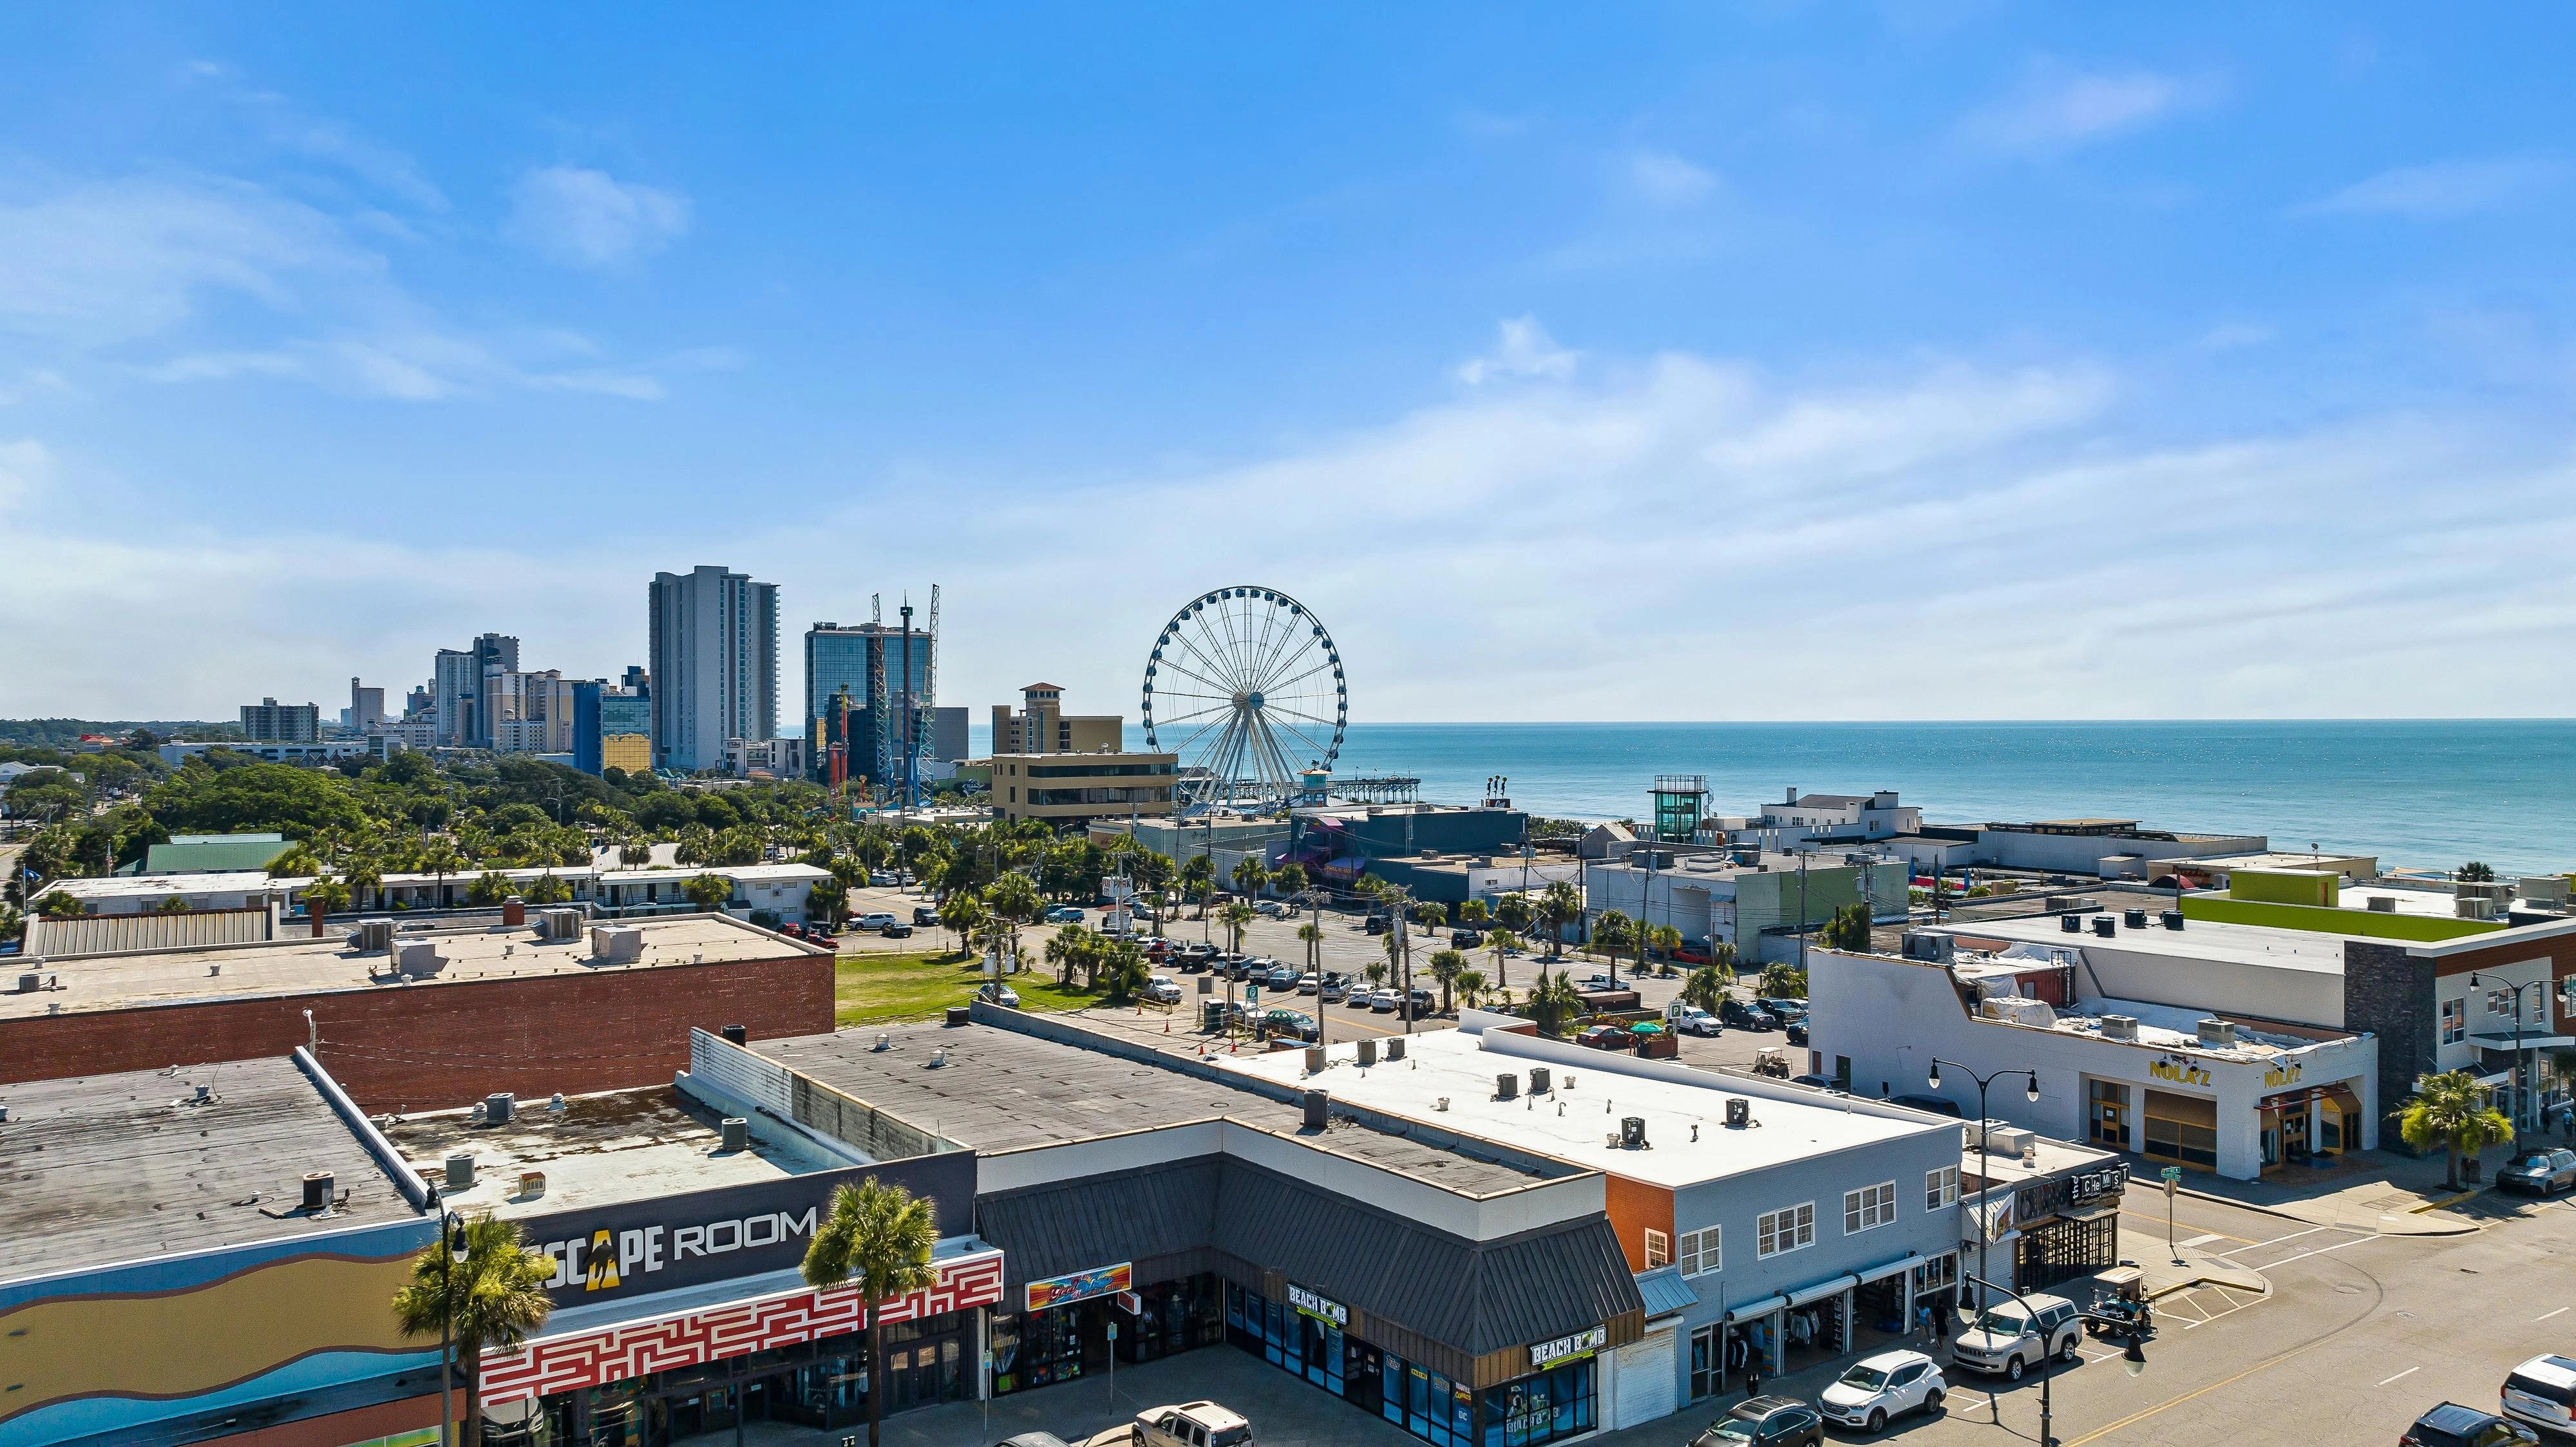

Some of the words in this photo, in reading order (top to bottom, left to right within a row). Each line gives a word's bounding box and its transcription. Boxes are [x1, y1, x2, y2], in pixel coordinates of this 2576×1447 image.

[1674, 1007, 1679, 1016] P
[674, 1207, 817, 1261] ROOM
[1289, 1287, 1318, 1312] BEACH
[1320, 1299, 1347, 1323] BOMB
[1532, 1338, 1571, 1363] BEACH
[1574, 1329, 1605, 1352] BOMB
[1459, 1410, 1467, 1421] DC
